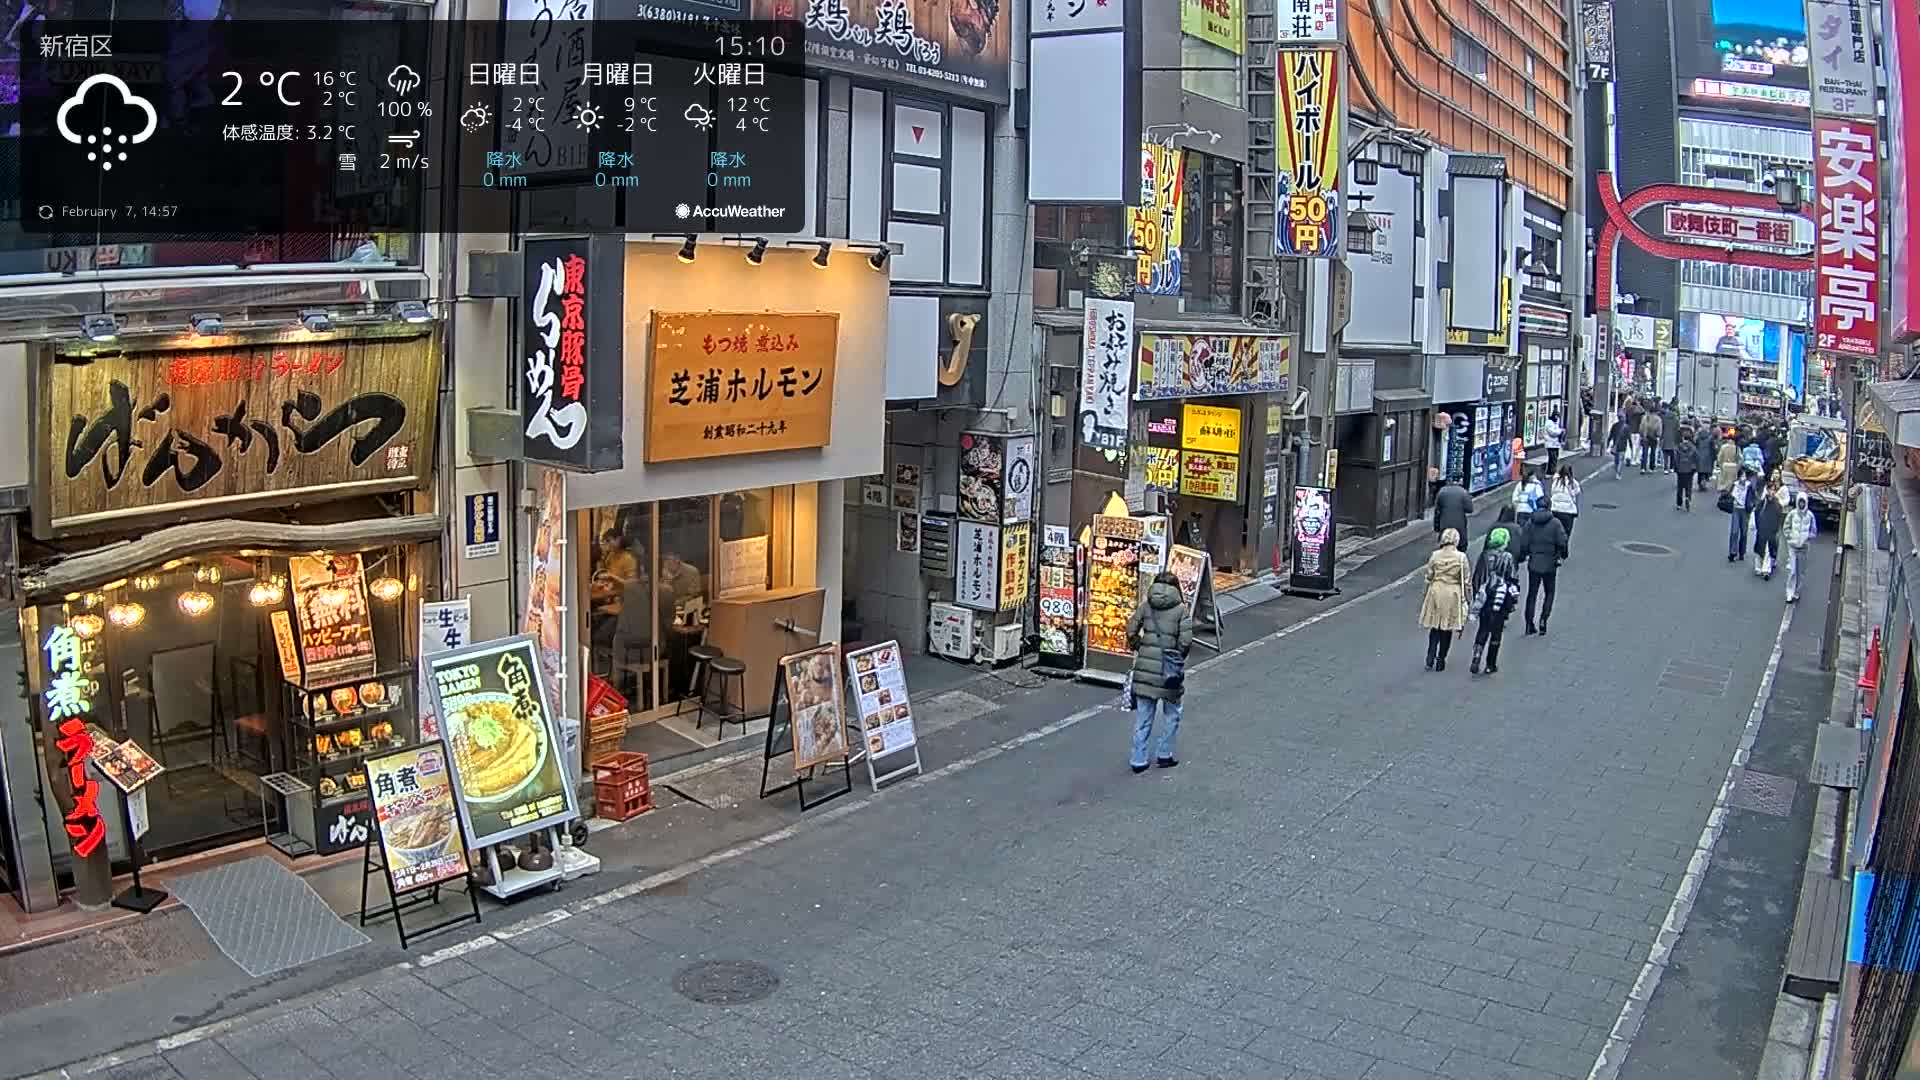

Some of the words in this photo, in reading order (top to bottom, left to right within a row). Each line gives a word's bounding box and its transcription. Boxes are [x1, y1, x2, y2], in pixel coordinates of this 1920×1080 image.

[1590, 63, 1610, 80] 7F
[1832, 97, 1856, 113] 3F
[1295, 54, 1322, 191] ハイボール
[1669, 211, 1790, 244] 歌舞伎町一番街
[1818, 126, 1876, 332] 安楽亭
[560, 253, 586, 401] 東京豚骨
[1818, 332, 1837, 348] 2F
[1098, 309, 1129, 415] お好み焼き
[668, 365, 823, 406] 芝浦ホルモン
[302, 623, 372, 646] ハッピーアワー
[434, 663, 481, 684] TOKYO
[438, 676, 482, 697] RAMEN
[497, 652, 541, 721] 角煮
[374, 765, 420, 799] 角煮
